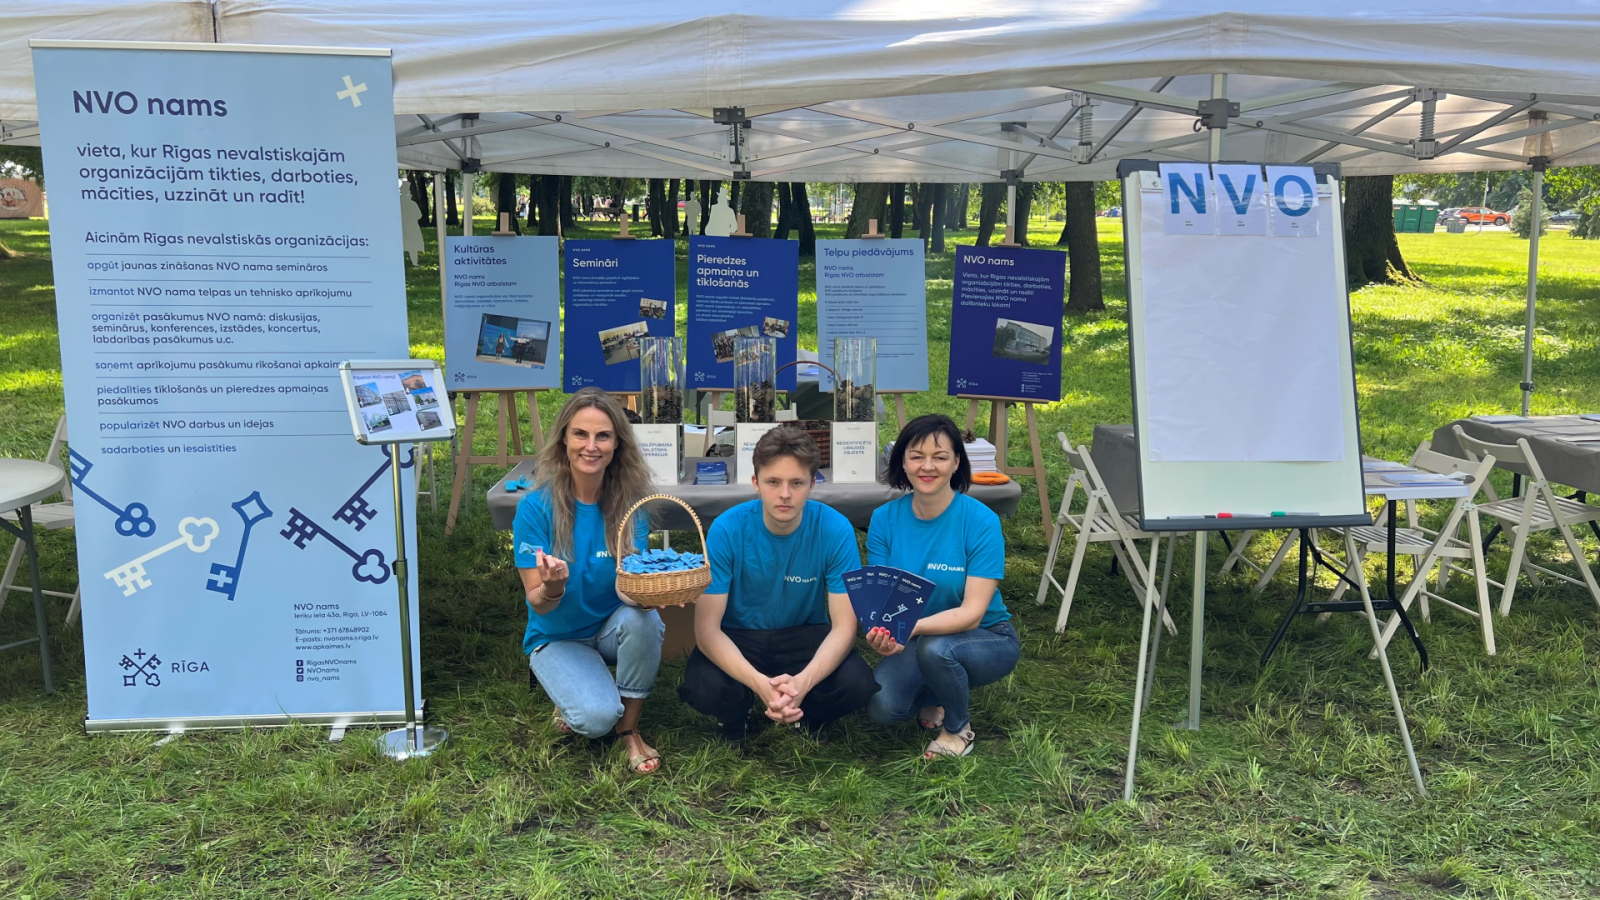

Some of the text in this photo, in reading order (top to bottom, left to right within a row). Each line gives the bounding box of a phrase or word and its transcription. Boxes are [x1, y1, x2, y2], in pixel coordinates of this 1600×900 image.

[73, 90, 228, 117] NVO nams
[77, 143, 345, 165] vieta, kur Rīgas nevalstiskajām
[79, 165, 358, 186] organizācijām tikties, darboties,
[81, 186, 305, 203] mācīties, uzzināt un radīt!
[85, 231, 369, 249] Aicinām Rīgas nevalstiskās organizācijas:
[454, 245, 495, 254] Kultūras
[824, 248, 914, 258] Telpu piedāvājums
[454, 257, 507, 265] aktivitātes
[572, 258, 619, 268] Semināri
[697, 254, 747, 266] Pieredzes
[963, 255, 1015, 266] NVO nams
[87, 260, 328, 272] apgūt jaunas zināšanas NVO nama semināros
[697, 267, 744, 279] apmaiņa
[697, 277, 749, 288] tīklošanās
[1007, 275, 1050, 283] nevalstiskajām
[89, 286, 135, 296] izmantot
[137, 287, 162, 296] NVO
[165, 289, 196, 297] nama
[198, 287, 231, 299] telpas
[249, 288, 293, 298] tehnisko
[295, 289, 352, 300] aprīkojumu
[961, 293, 994, 301] Pievienojies
[91, 312, 320, 324] organizēt pasākumus NVO namā: diskusijas,
[92, 323, 321, 334] seminārus, konferences, izstādes, koncertus,
[93, 335, 150, 345] labdarības
[153, 335, 214, 346] pasākumus
[95, 360, 341, 372] saņemt aprīkojumu pasākumu rīkošanai apkaim
[97, 384, 329, 396] piedalīties tīklošanās un pieredzes apmaiņas
[97, 396, 158, 406] pasākumos
[99, 419, 275, 432] popularizēt NVO darbus un idejas
[101, 444, 165, 454] sadarboties
[183, 444, 237, 453] iesaistīties
[927, 562, 948, 571] #NVO
[294, 603, 340, 611] NVO nams
[296, 643, 352, 651] www.apkaimes.lv
[171, 660, 210, 673] RĪGA
